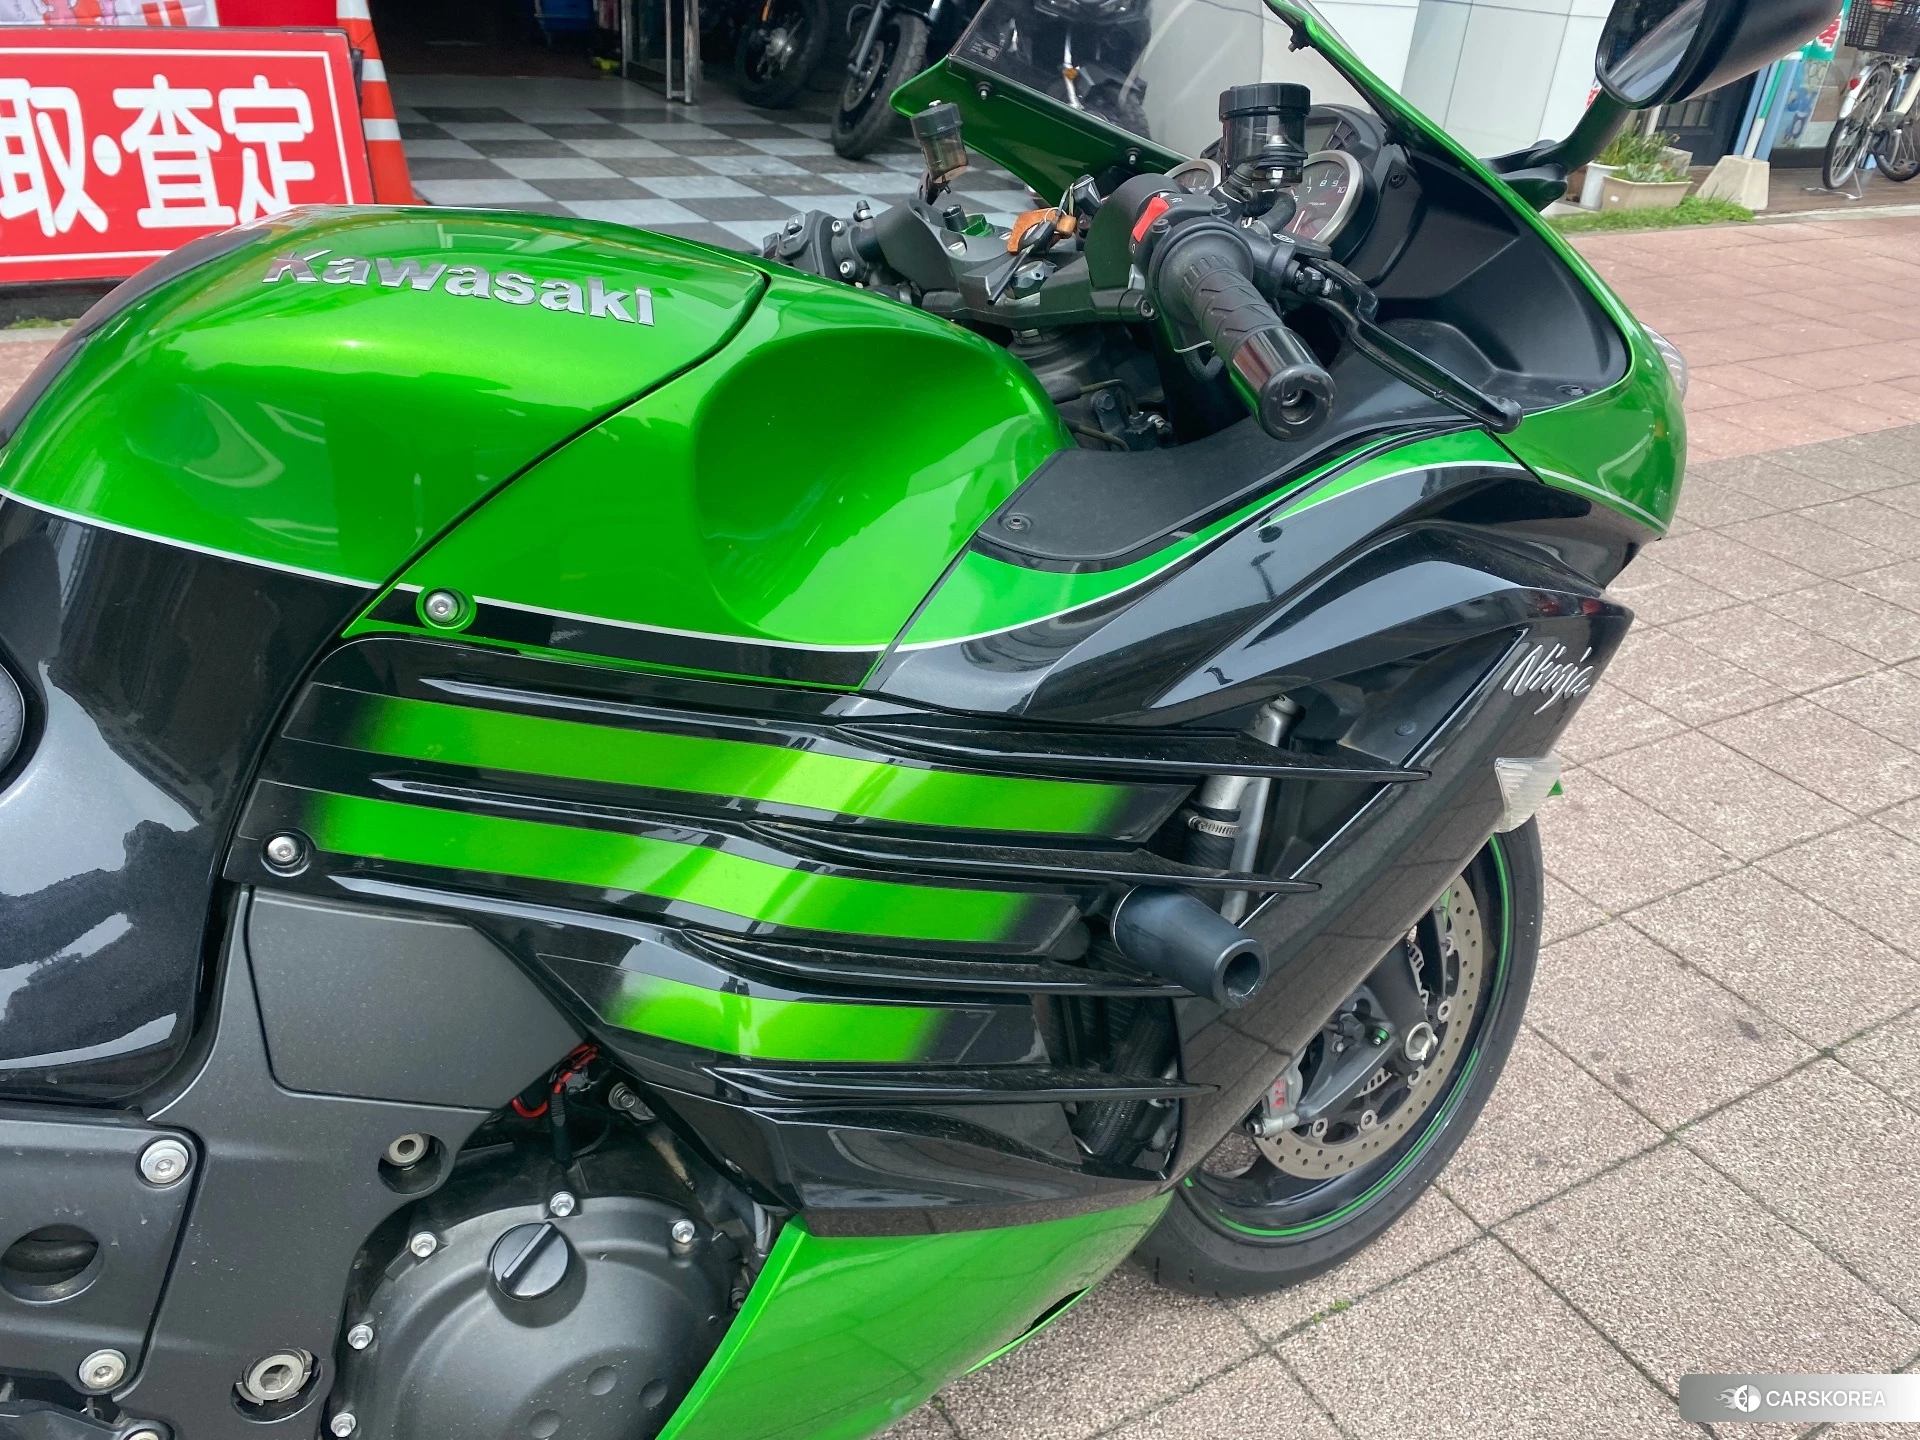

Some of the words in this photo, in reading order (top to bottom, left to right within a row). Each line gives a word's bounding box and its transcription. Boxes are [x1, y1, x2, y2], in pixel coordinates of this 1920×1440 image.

[1319, 179, 1328, 187] 8
[1332, 179, 1340, 187] 9
[1337, 186, 1347, 194] 10
[262, 248, 655, 327] Kawasaki
[1503, 643, 1595, 715] Ninja
